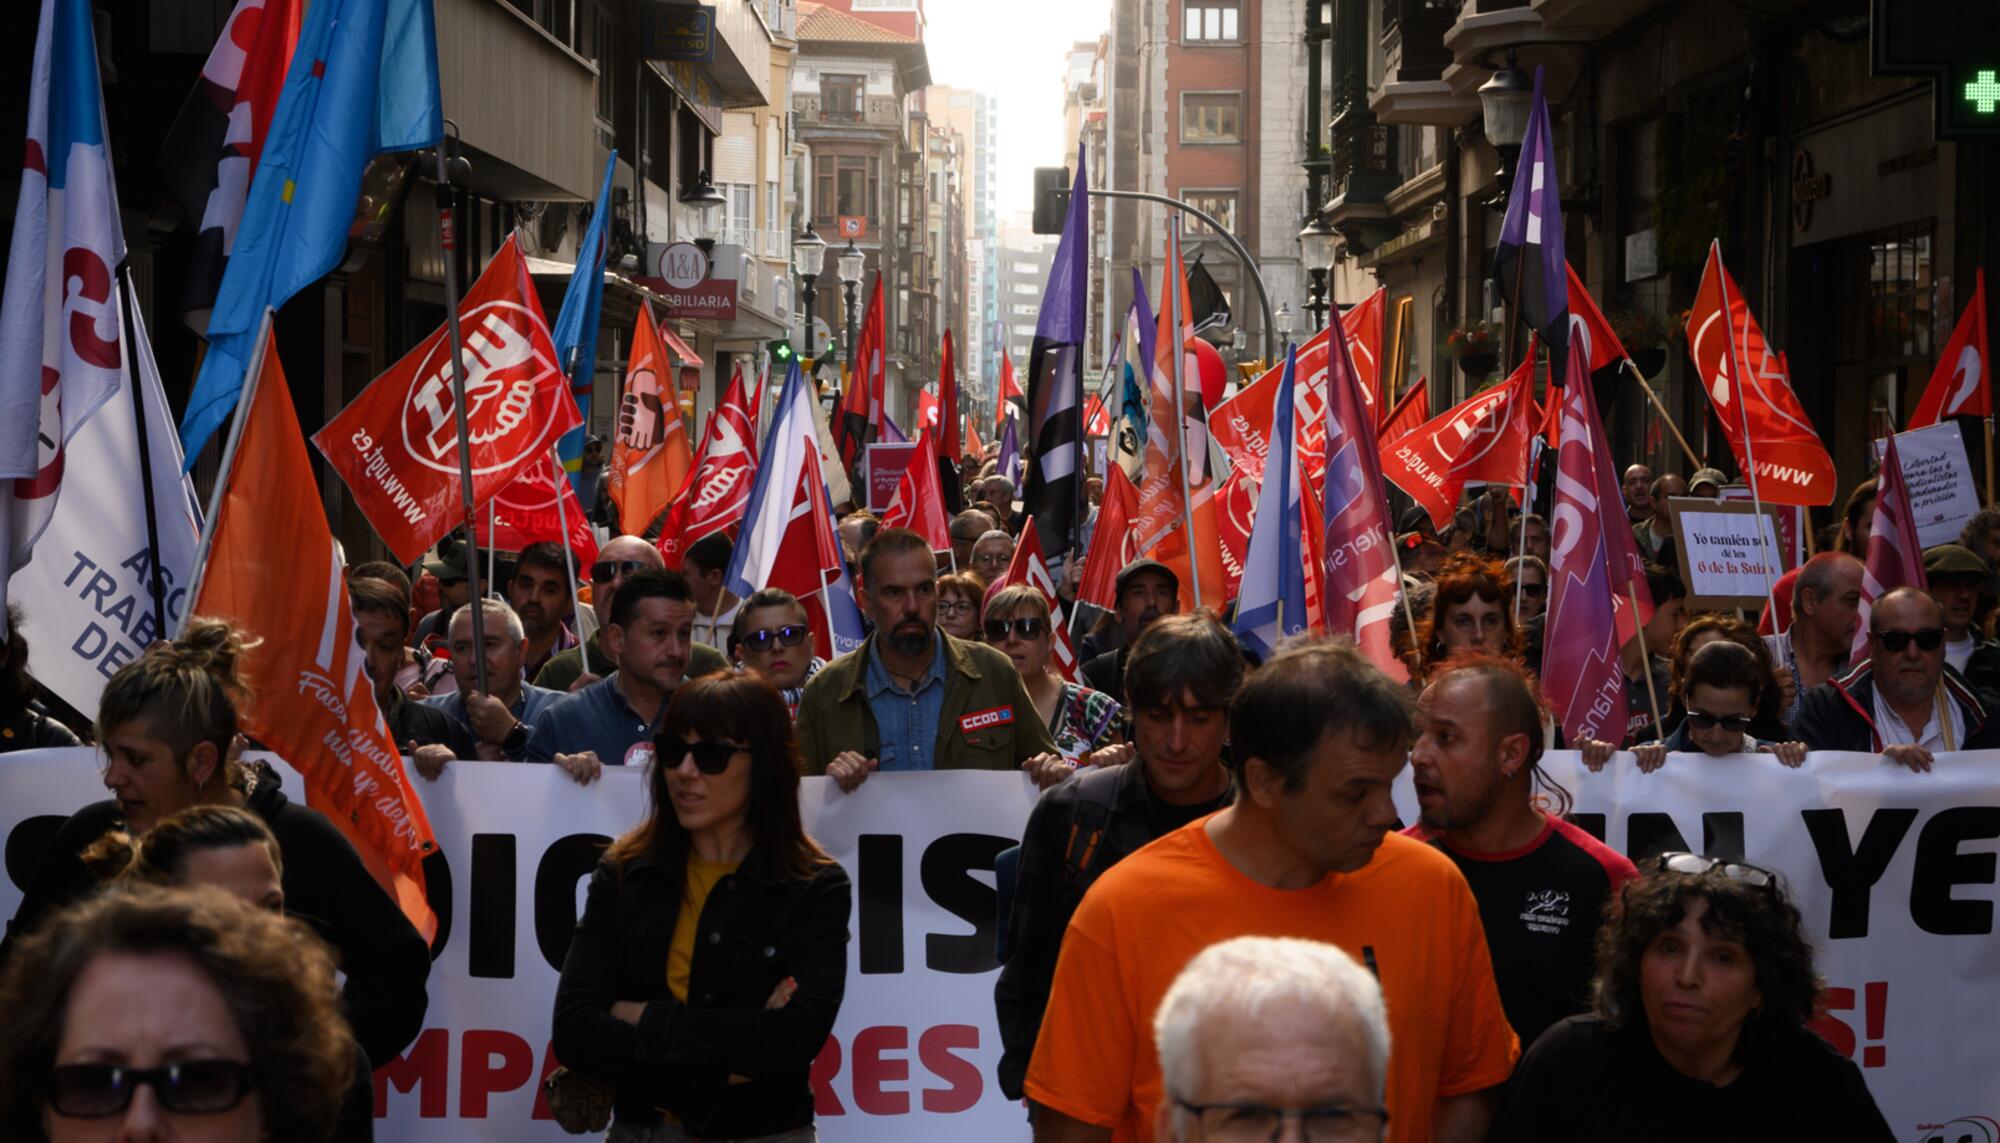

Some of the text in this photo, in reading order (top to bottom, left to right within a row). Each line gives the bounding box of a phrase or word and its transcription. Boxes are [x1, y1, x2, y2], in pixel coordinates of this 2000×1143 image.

[666, 252, 701, 280] A&A
[1693, 532, 1708, 545] Yo
[1710, 534, 1750, 546] tamién
[1721, 548, 1732, 558] de
[1697, 561, 1706, 574] 6
[1709, 561, 1724, 574] de
[1727, 562, 1738, 574] la
[962, 711, 1000, 730] CCOO
[1801, 806, 2000, 939] YE
